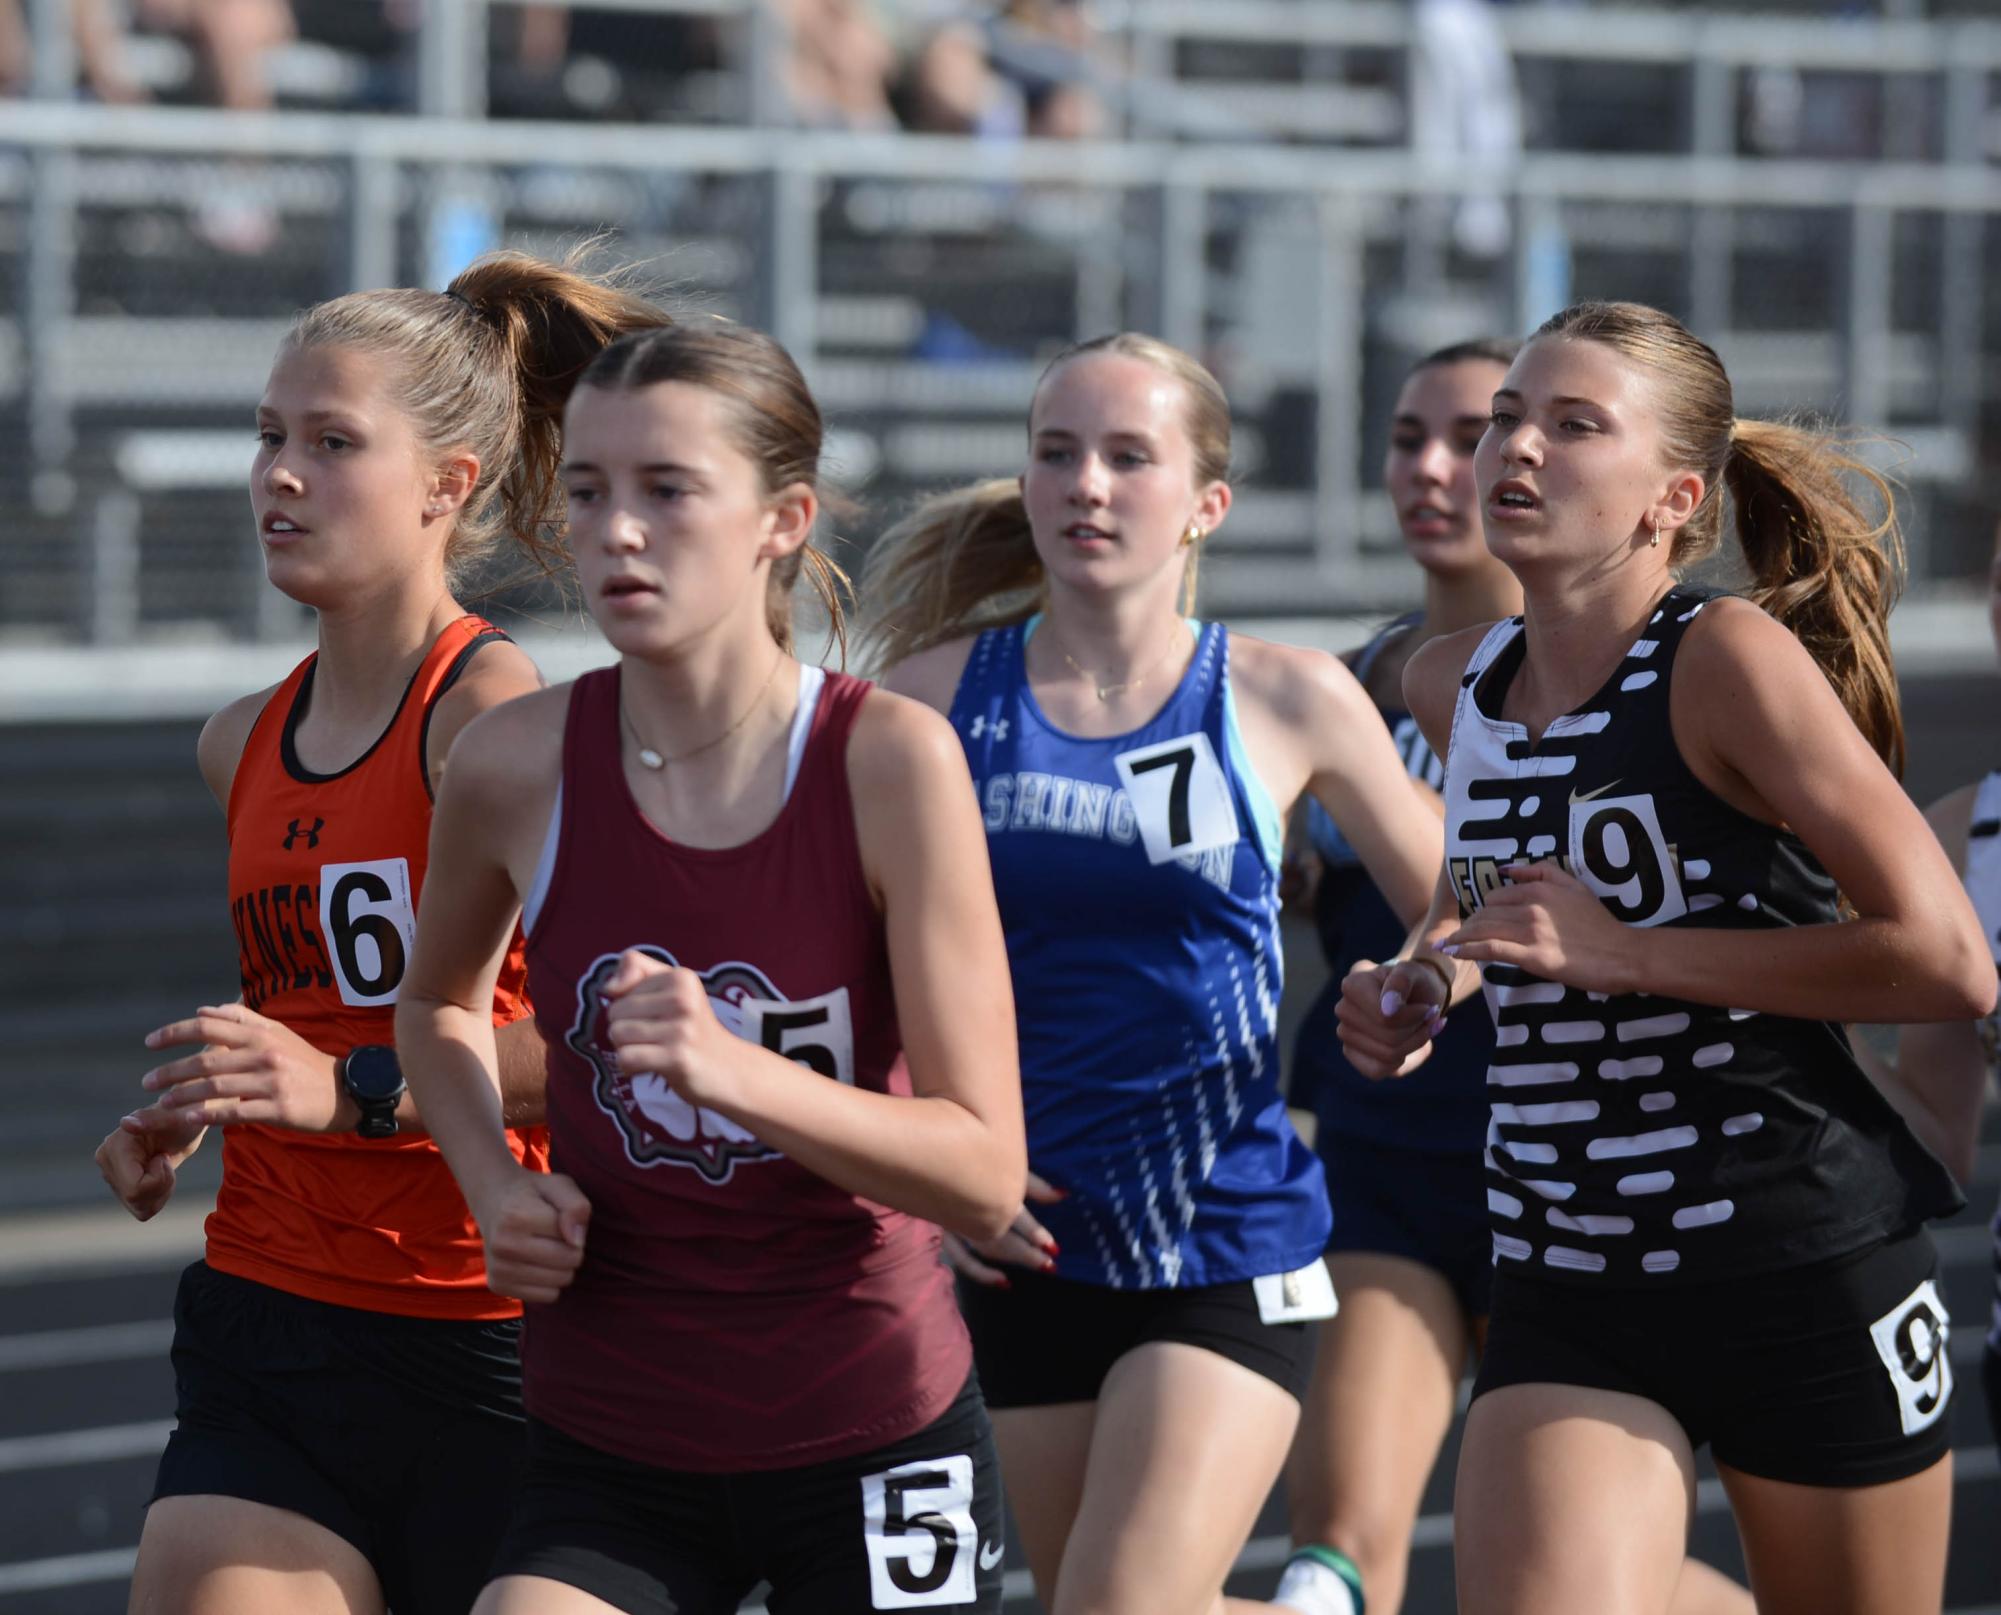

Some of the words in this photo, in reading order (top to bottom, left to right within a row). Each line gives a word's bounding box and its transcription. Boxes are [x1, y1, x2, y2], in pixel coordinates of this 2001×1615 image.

[973, 771, 1237, 893] SHINGN
[1129, 747, 1196, 848] 7
[1582, 807, 1665, 922] 9
[330, 871, 406, 997] 6
[1895, 1301, 1942, 1414] 9
[884, 1470, 958, 1594] 5
